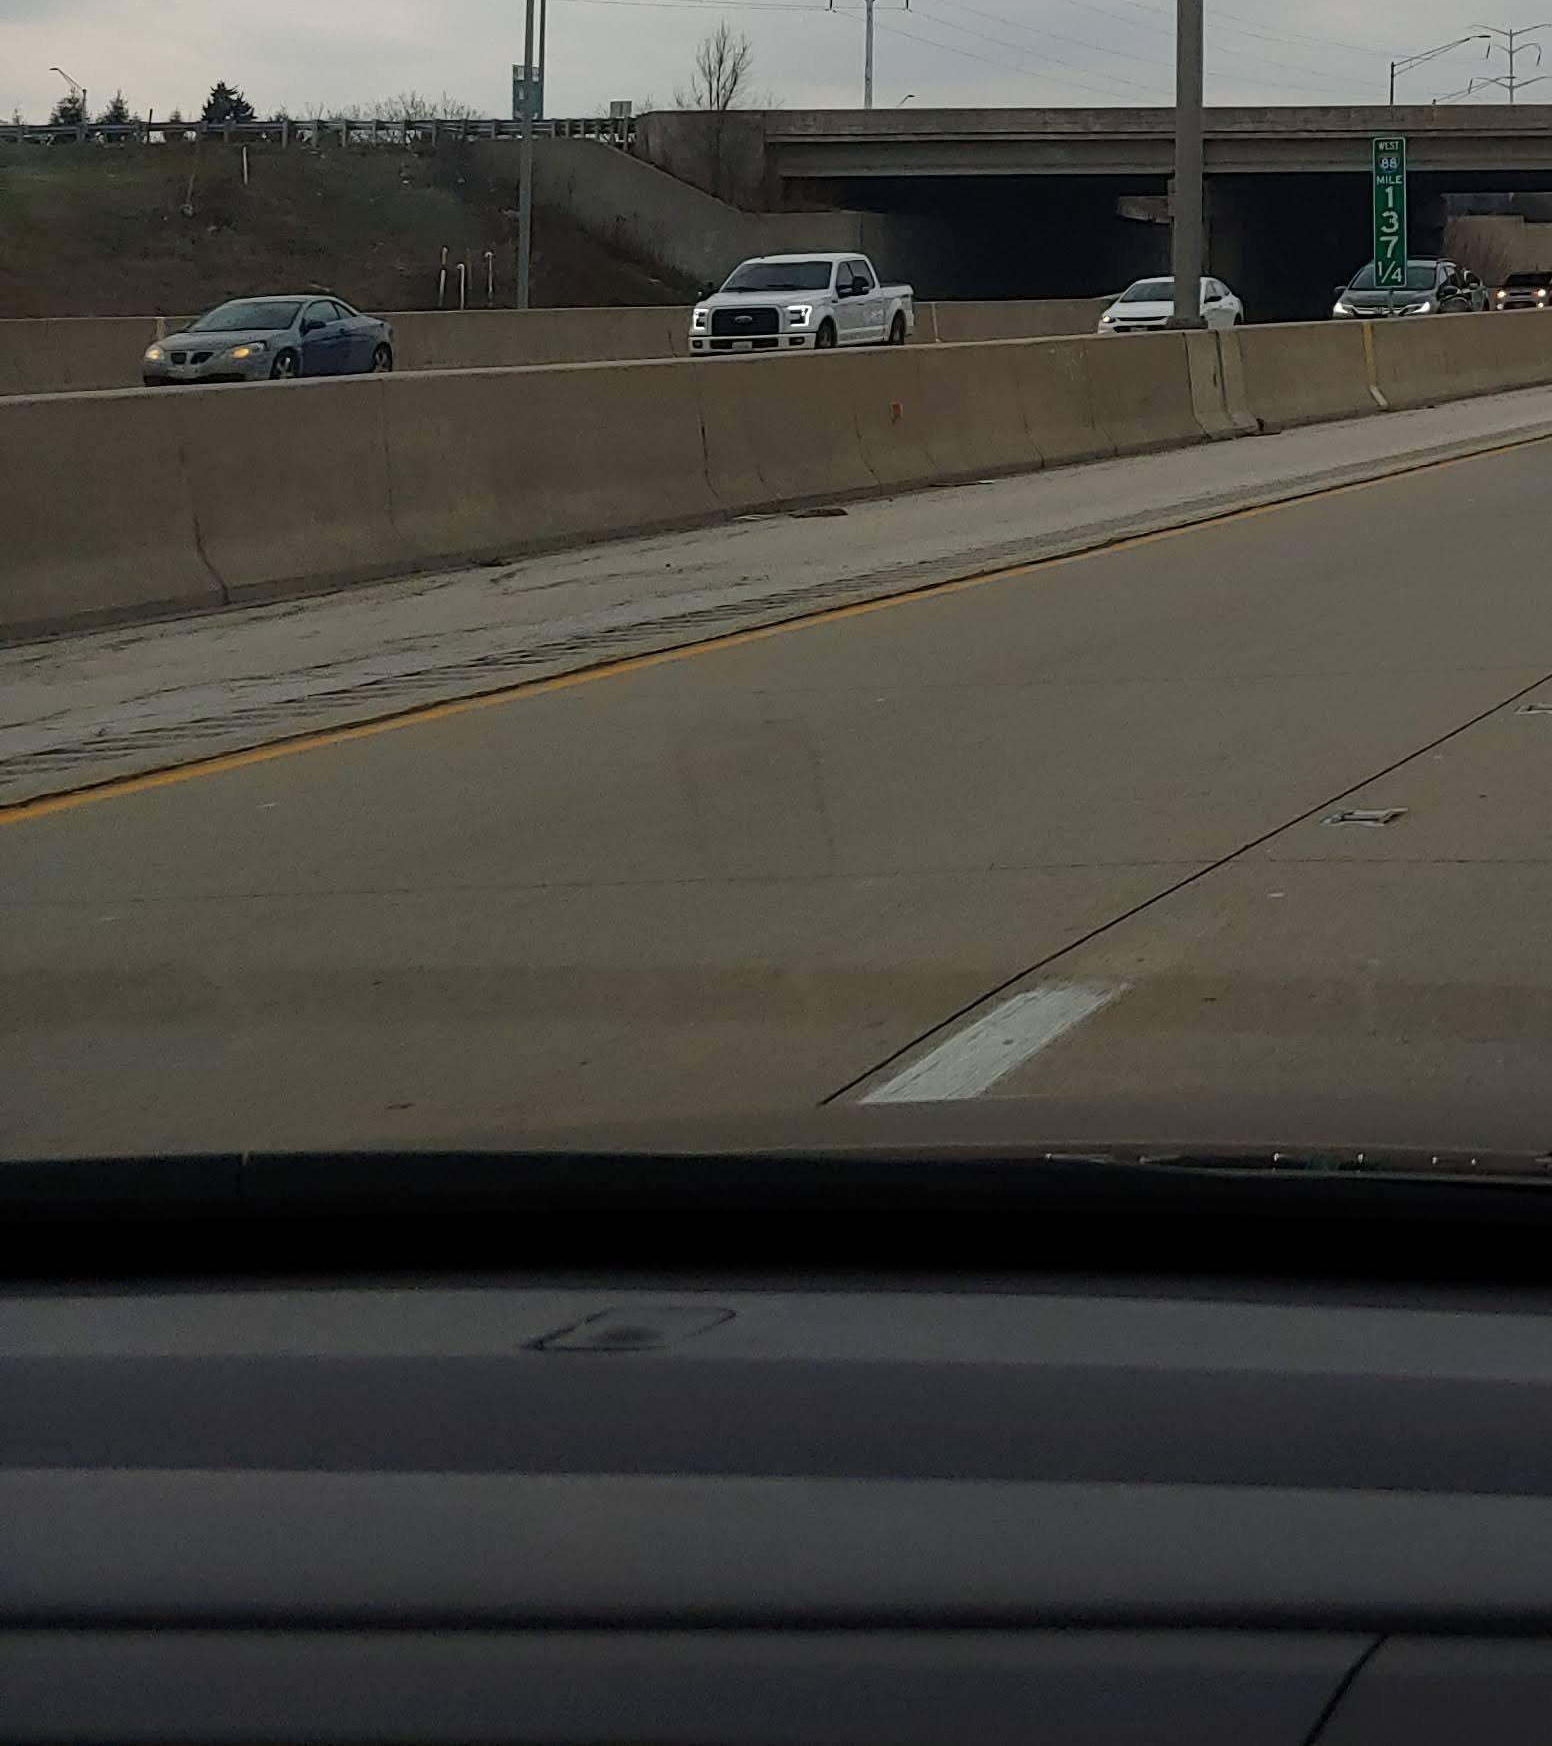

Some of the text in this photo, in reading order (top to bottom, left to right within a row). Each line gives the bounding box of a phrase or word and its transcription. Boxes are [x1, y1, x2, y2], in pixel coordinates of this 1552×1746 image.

[1378, 141, 1399, 151] WEST
[1381, 157, 1398, 169] 88
[1376, 175, 1403, 185] MILE
[1377, 260, 1403, 284] 1/4
